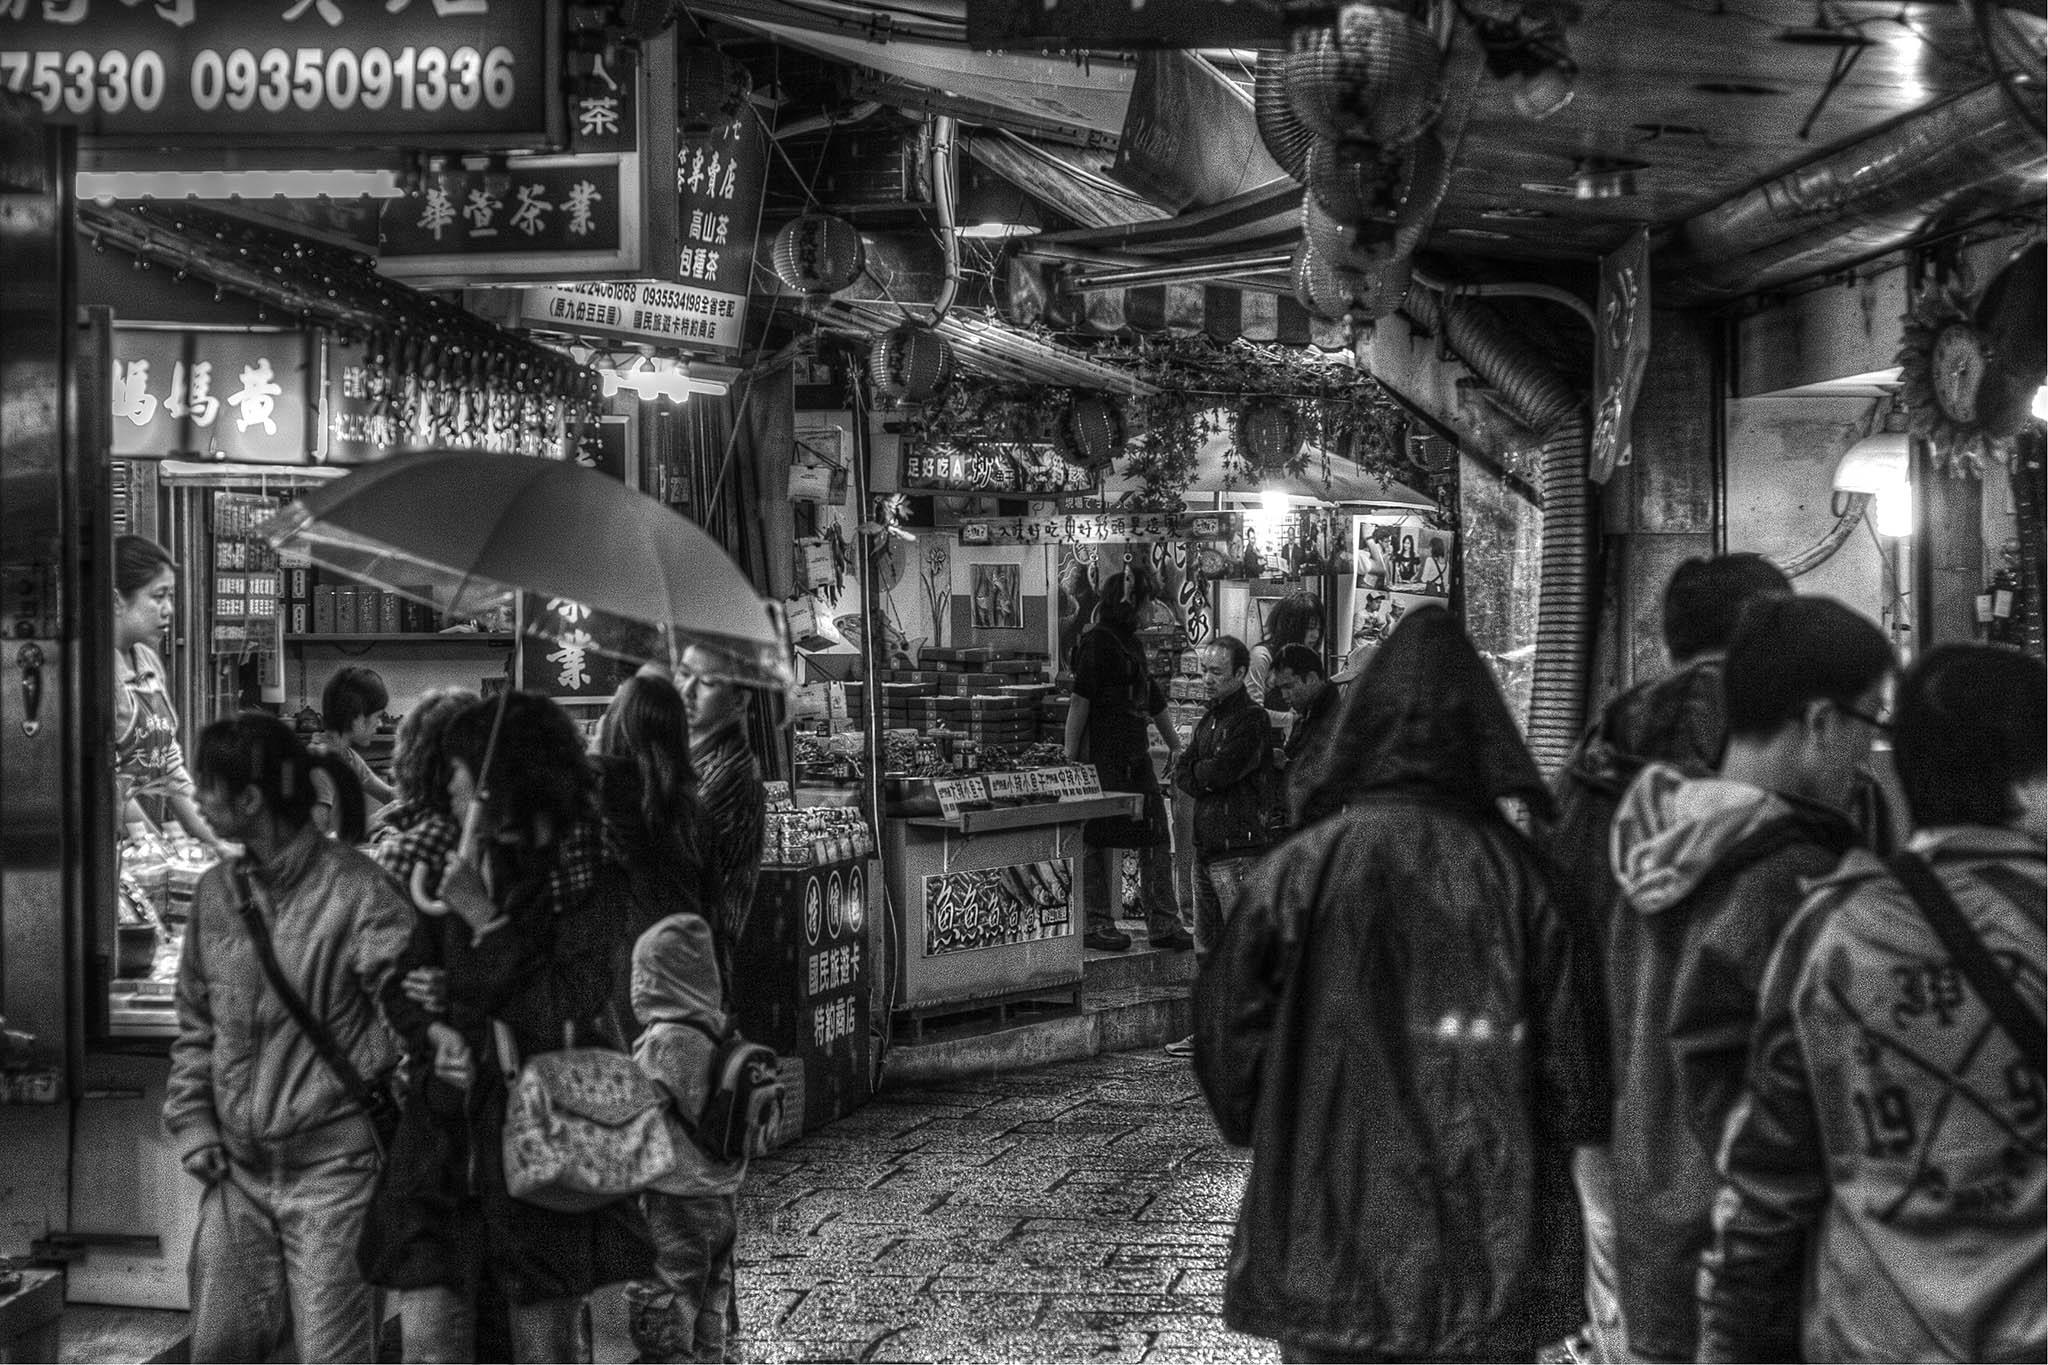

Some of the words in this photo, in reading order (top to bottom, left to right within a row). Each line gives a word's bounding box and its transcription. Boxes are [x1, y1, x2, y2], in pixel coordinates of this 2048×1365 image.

[190, 46, 515, 112] 0935091336
[688, 208, 730, 245] 高山茶
[679, 244, 720, 282] 包種茶
[808, 941, 861, 996] 國民旅遊卡
[814, 995, 857, 1047] 特約商店
